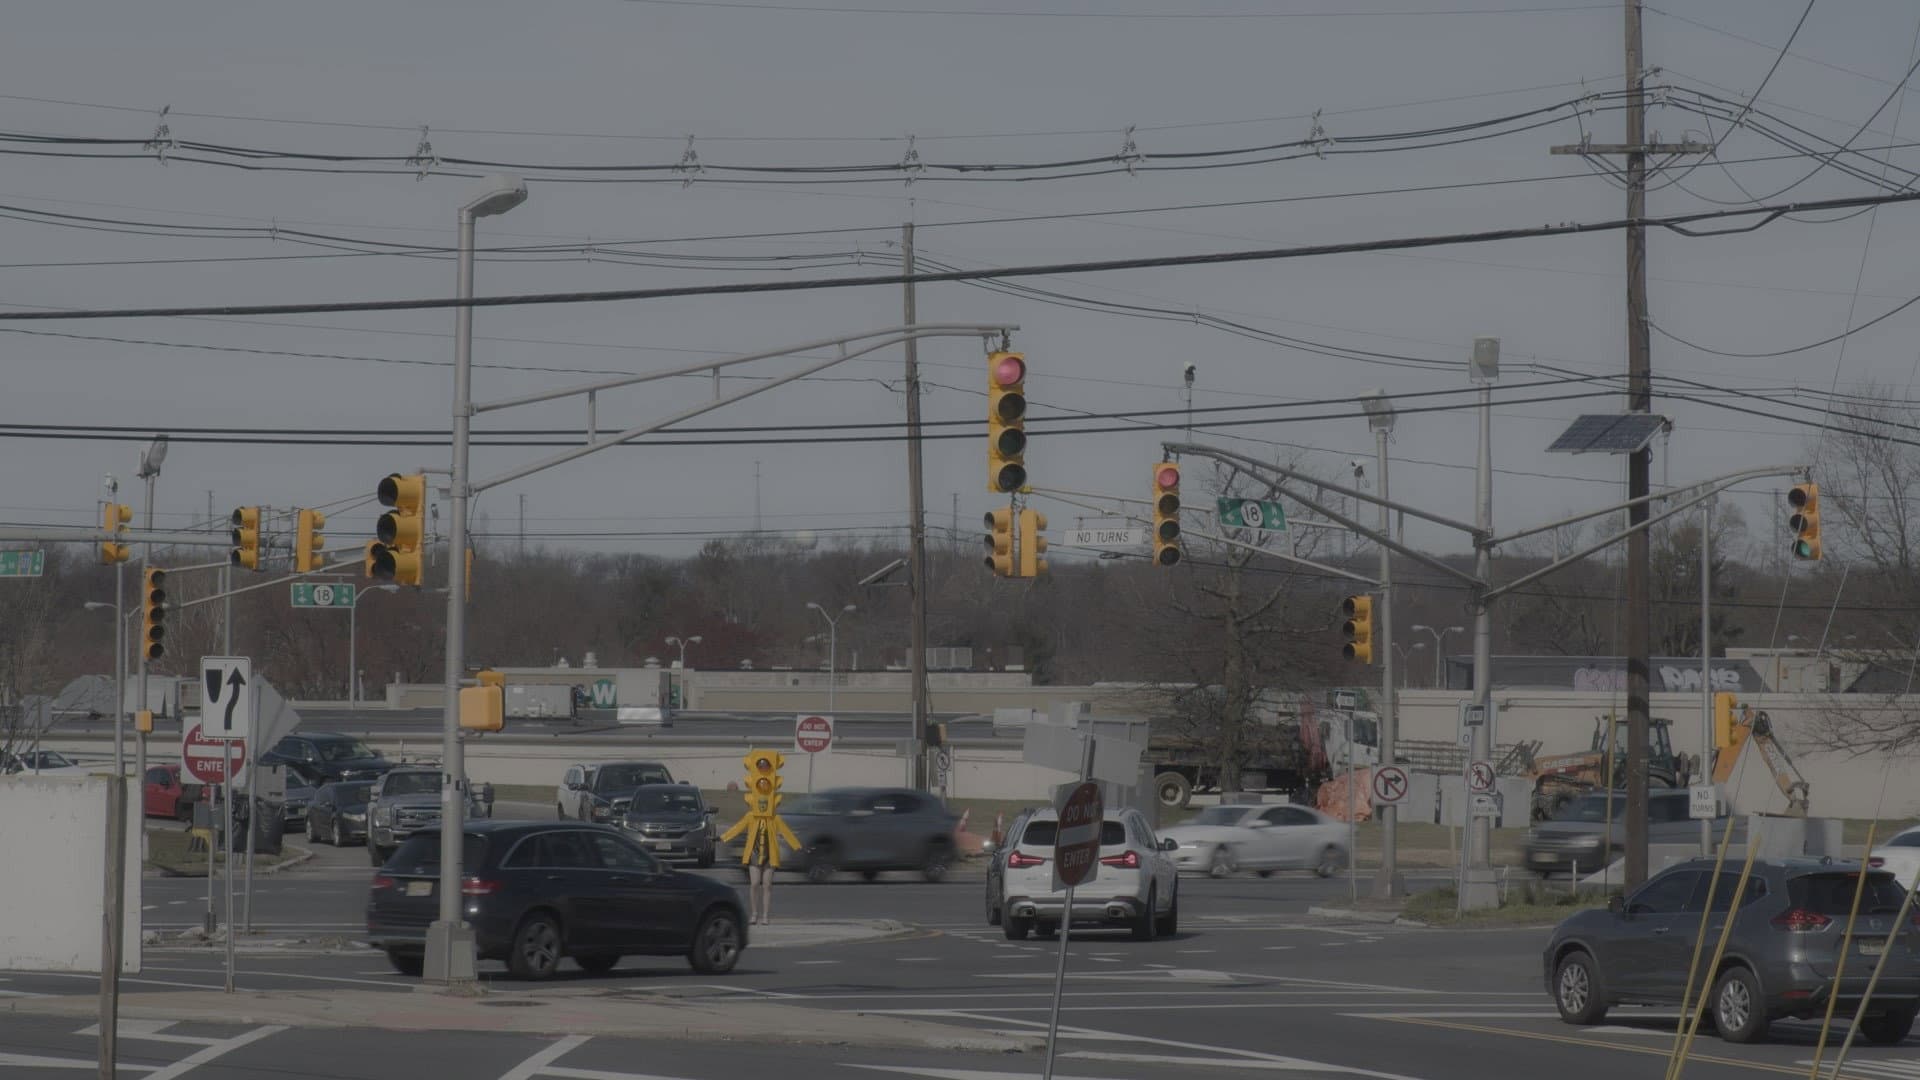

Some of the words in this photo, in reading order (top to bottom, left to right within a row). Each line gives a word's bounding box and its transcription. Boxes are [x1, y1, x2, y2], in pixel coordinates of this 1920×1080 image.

[1244, 505, 1260, 522] 18
[1076, 531, 1091, 543] NO
[1096, 531, 1129, 543] TURNS
[316, 589, 330, 601] 18
[196, 760, 225, 772] ENTE
[1696, 791, 1709, 801] NO
[1063, 848, 1090, 869] ENTER
